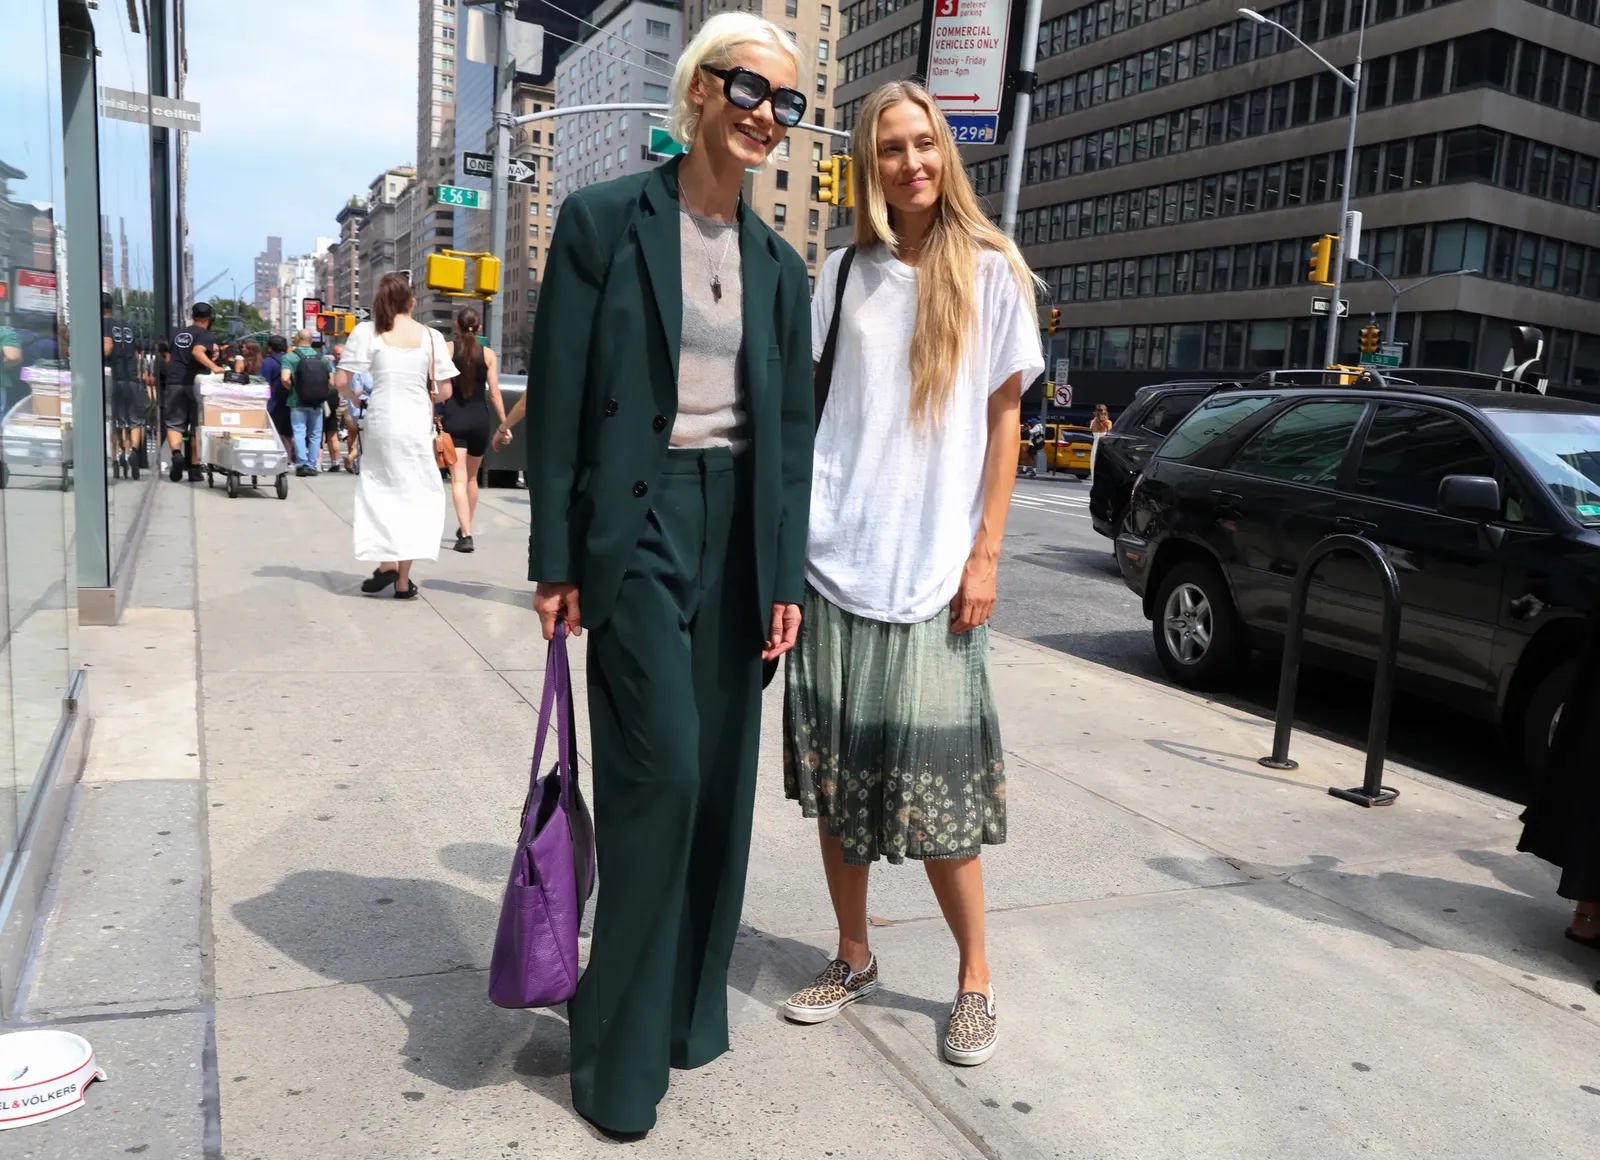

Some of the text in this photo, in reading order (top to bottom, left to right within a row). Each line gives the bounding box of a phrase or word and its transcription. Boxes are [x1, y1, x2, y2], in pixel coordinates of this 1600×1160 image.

[941, 0, 954, 15] 3
[960, 1, 986, 9] metered
[960, 9, 982, 17] parking
[936, 26, 992, 37] COMMERCIAL
[935, 38, 999, 50] VEHICLES ONLY
[933, 56, 960, 66] Monday
[965, 56, 987, 66] Friday
[955, 67, 969, 77] 4pm
[152, 107, 200, 122] cellini
[469, 159, 493, 173] ONE
[440, 187, 475, 204] E 56 ST
